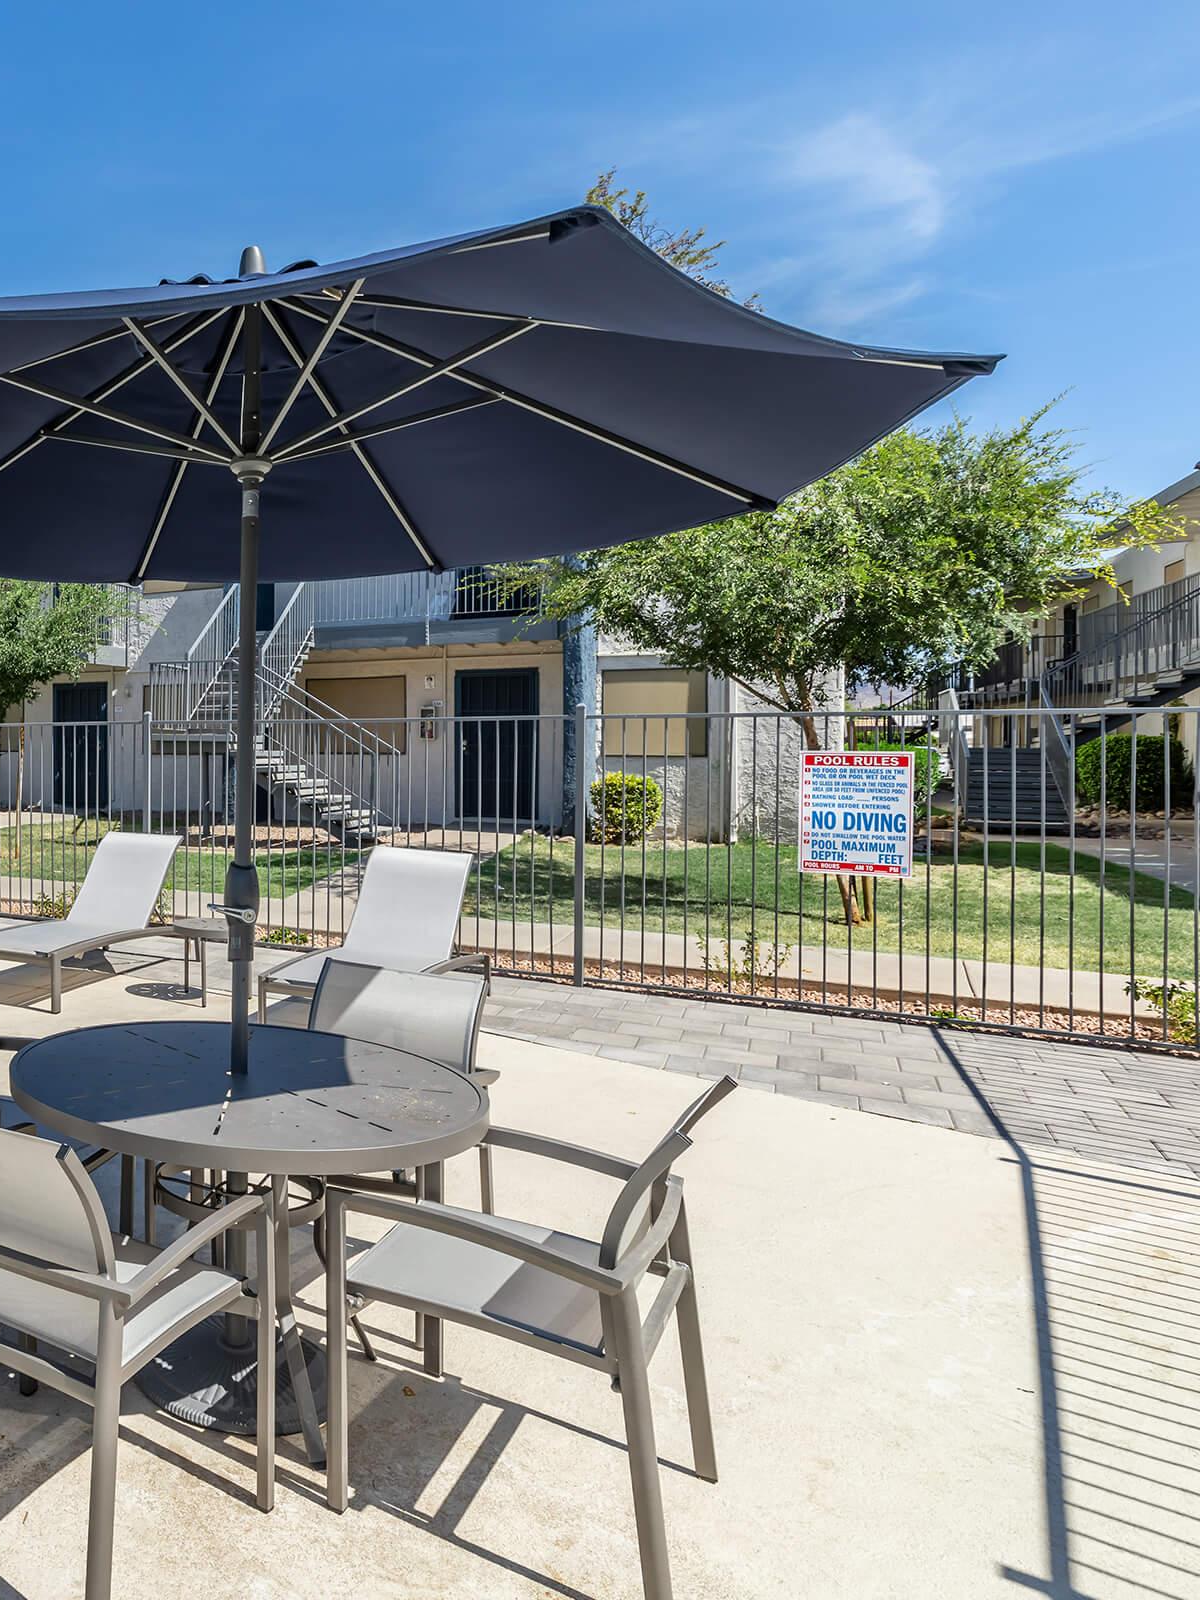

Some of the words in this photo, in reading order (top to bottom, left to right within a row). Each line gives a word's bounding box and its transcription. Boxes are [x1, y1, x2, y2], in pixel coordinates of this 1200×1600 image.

[814, 757, 849, 765] POOL
[854, 757, 899, 766] RULES
[812, 811, 836, 829] NO
[844, 813, 906, 832] DIVING
[812, 840, 838, 849] POOL
[842, 841, 895, 853] MAXIMUM
[811, 851, 847, 861] DEPTH:
[879, 854, 904, 864] FEET
